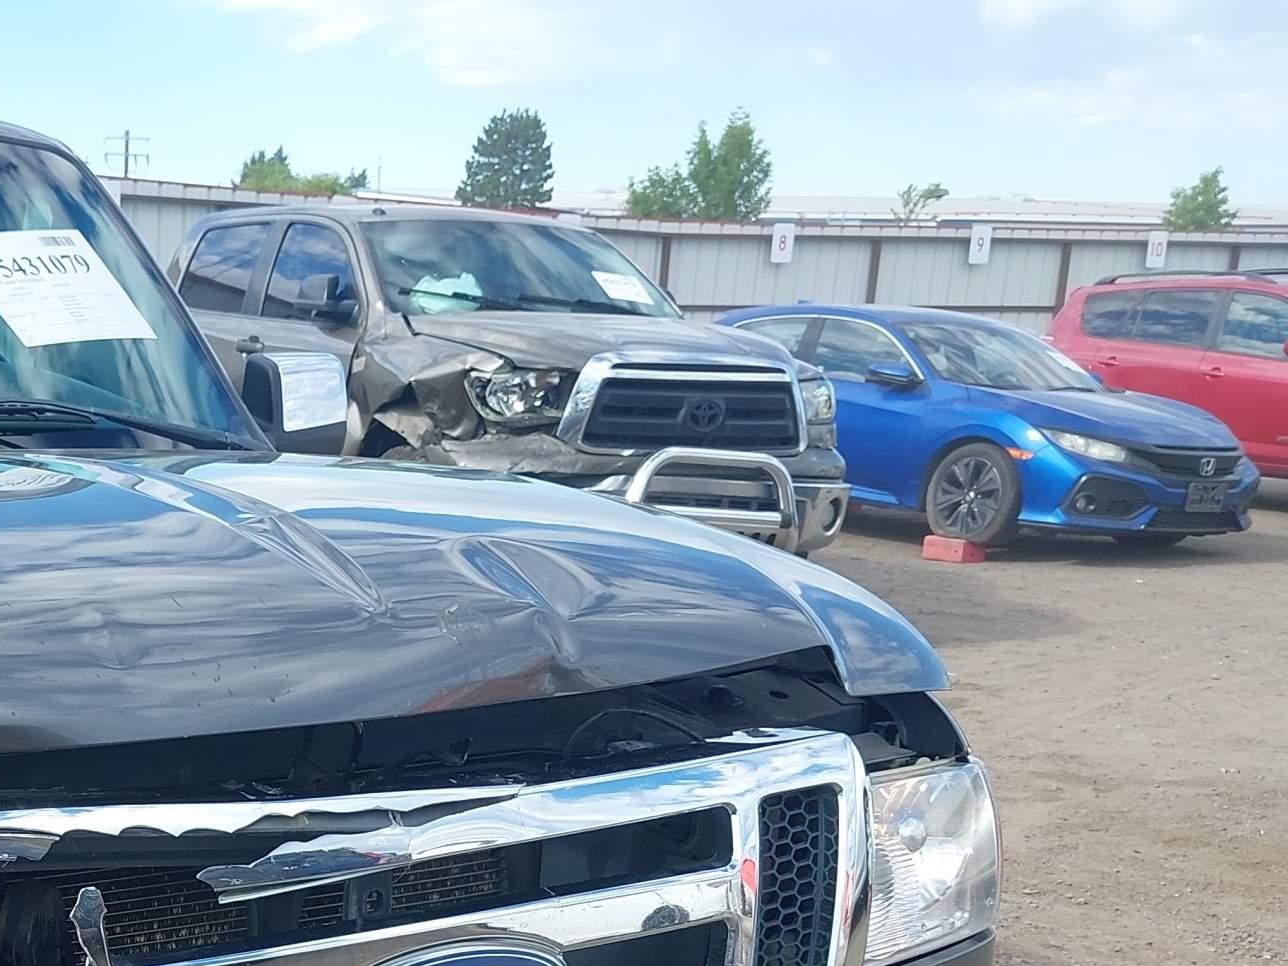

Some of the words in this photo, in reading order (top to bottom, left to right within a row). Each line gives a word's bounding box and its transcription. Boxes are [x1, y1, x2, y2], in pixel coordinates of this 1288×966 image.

[778, 235, 787, 251] 8
[977, 236, 985, 252] 9
[1150, 241, 1163, 257] 10
